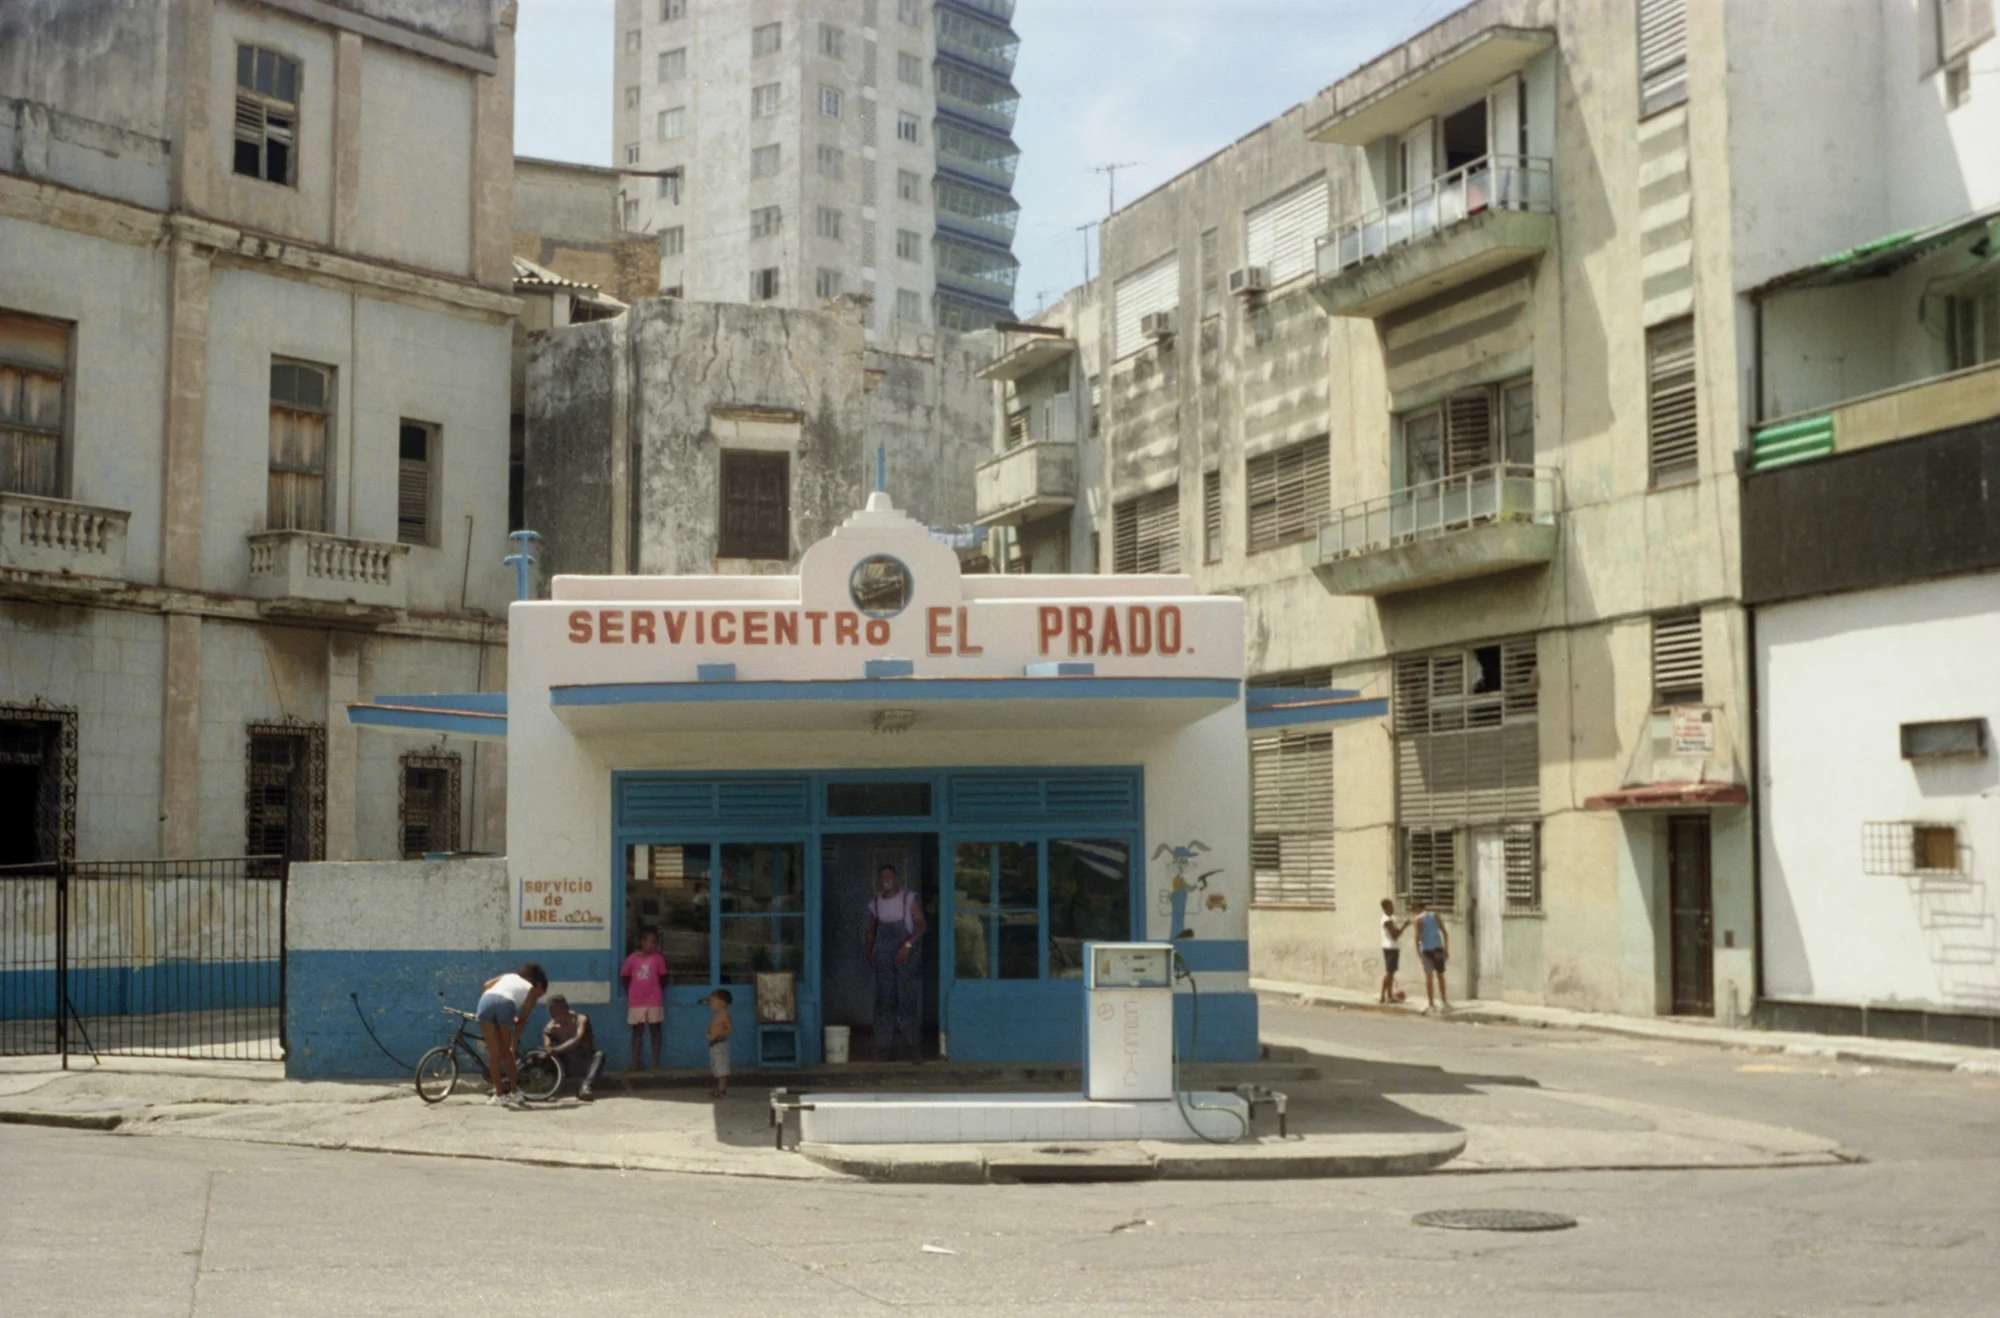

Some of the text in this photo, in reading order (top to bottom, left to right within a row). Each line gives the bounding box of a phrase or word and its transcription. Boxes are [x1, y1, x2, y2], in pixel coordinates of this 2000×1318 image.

[926, 606, 984, 657] EL
[1037, 605, 1195, 657] PRADO.
[524, 876, 592, 893] servicio
[543, 892, 563, 906] de
